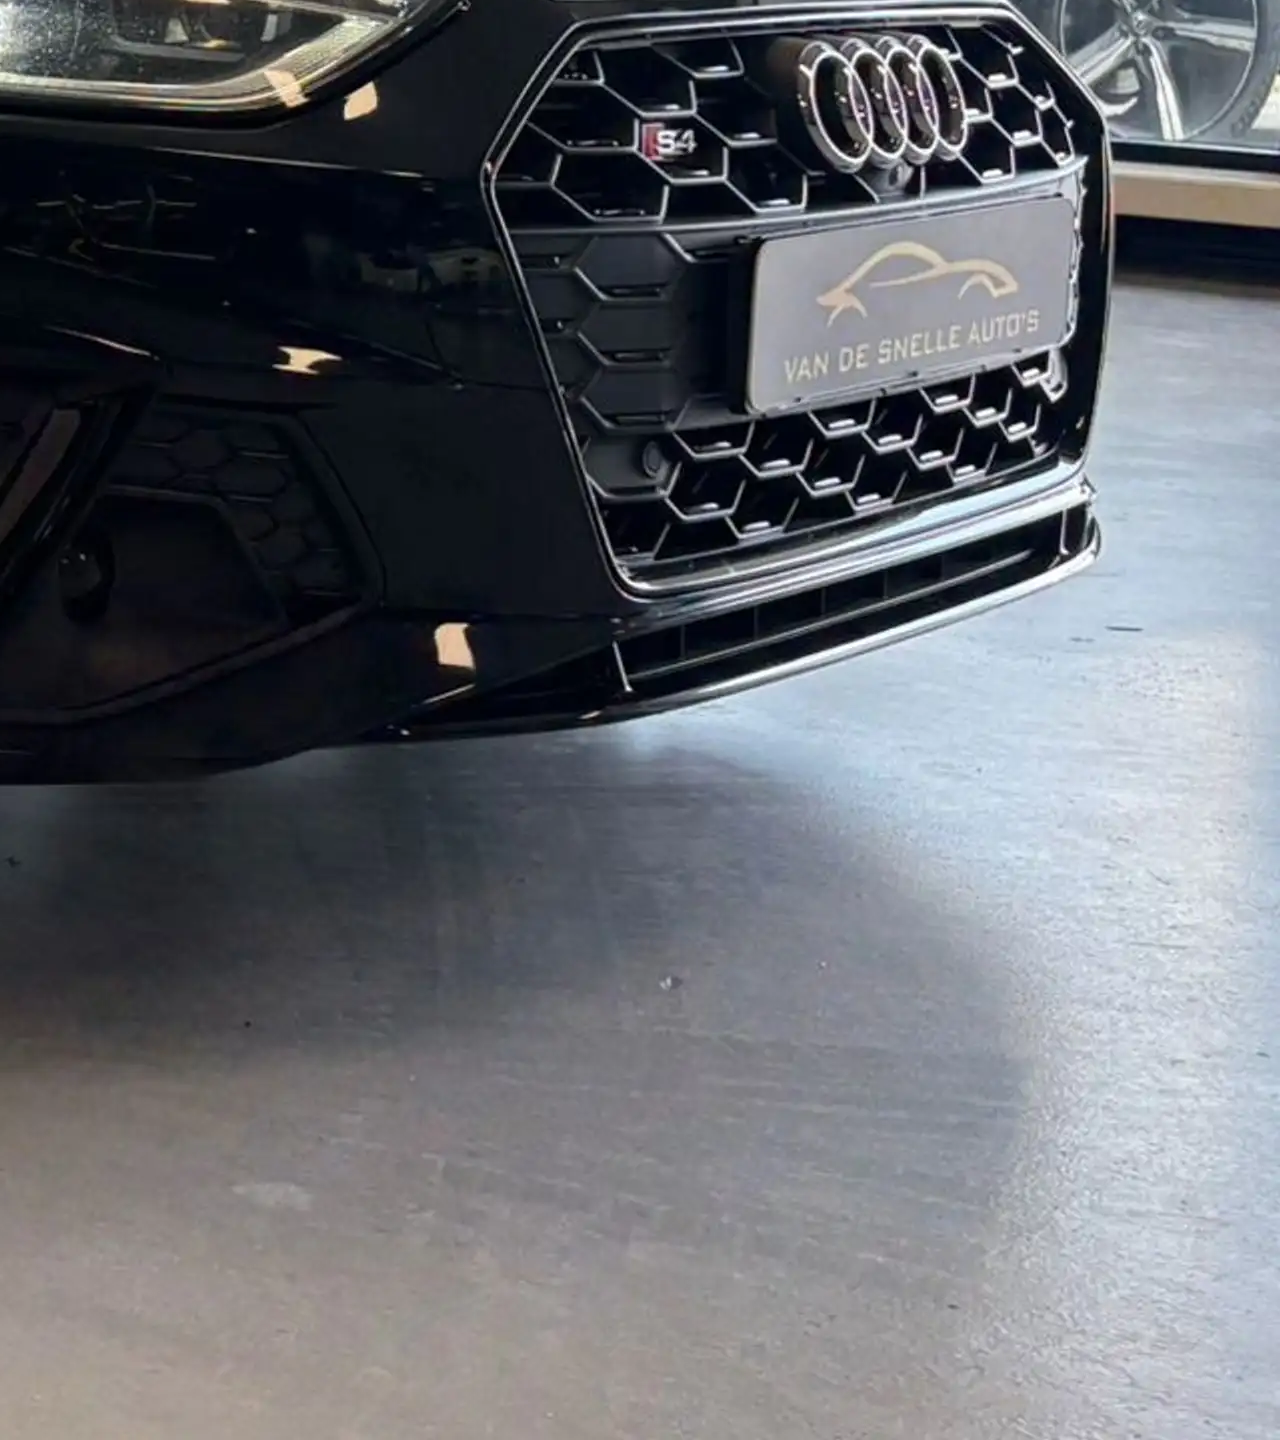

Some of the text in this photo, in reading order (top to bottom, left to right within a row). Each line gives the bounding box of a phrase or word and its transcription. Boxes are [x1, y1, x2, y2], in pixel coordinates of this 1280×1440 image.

[784, 309, 1041, 384] VAN DE SNELLE AUTO'S
